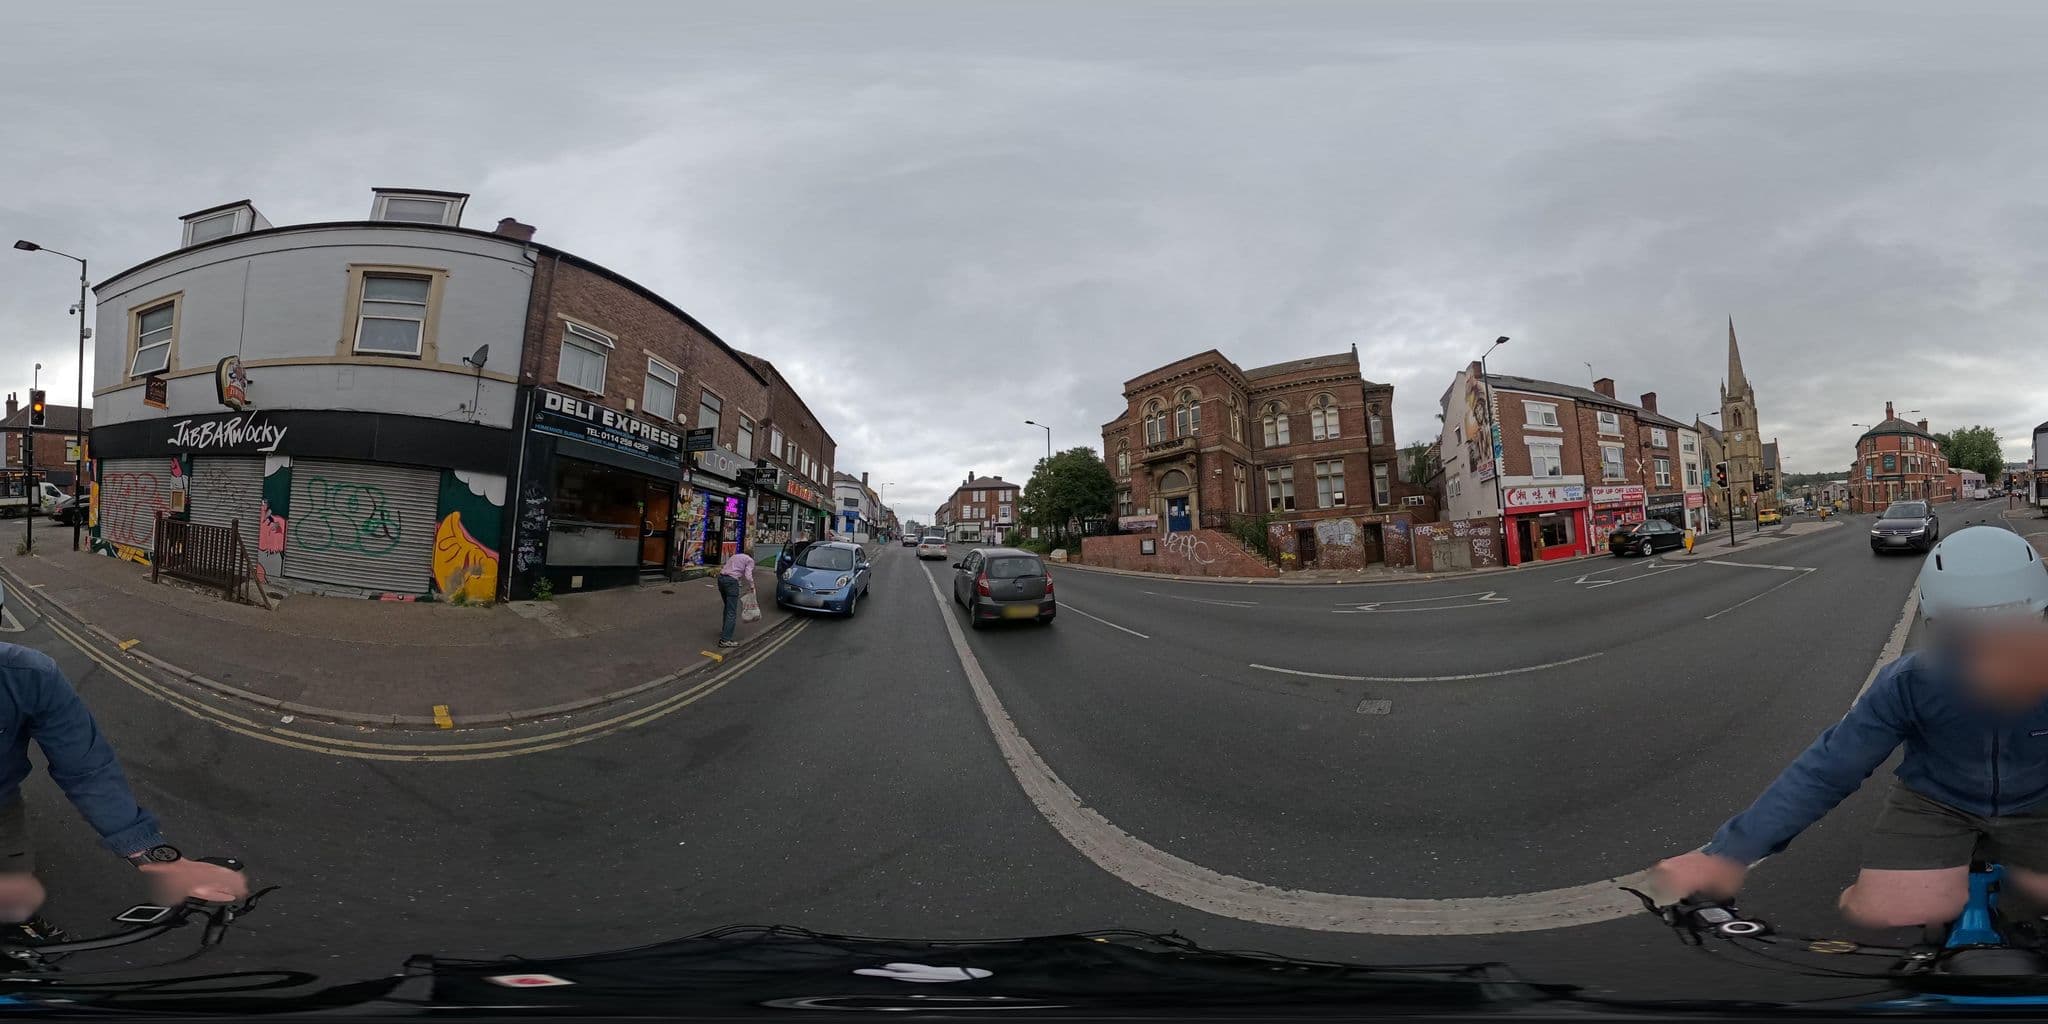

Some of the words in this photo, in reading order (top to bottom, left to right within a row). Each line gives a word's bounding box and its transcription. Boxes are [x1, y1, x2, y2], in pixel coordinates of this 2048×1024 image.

[545, 392, 594, 421] DELI
[602, 410, 679, 449] EXPRESS
[601, 431, 619, 444] 0114
